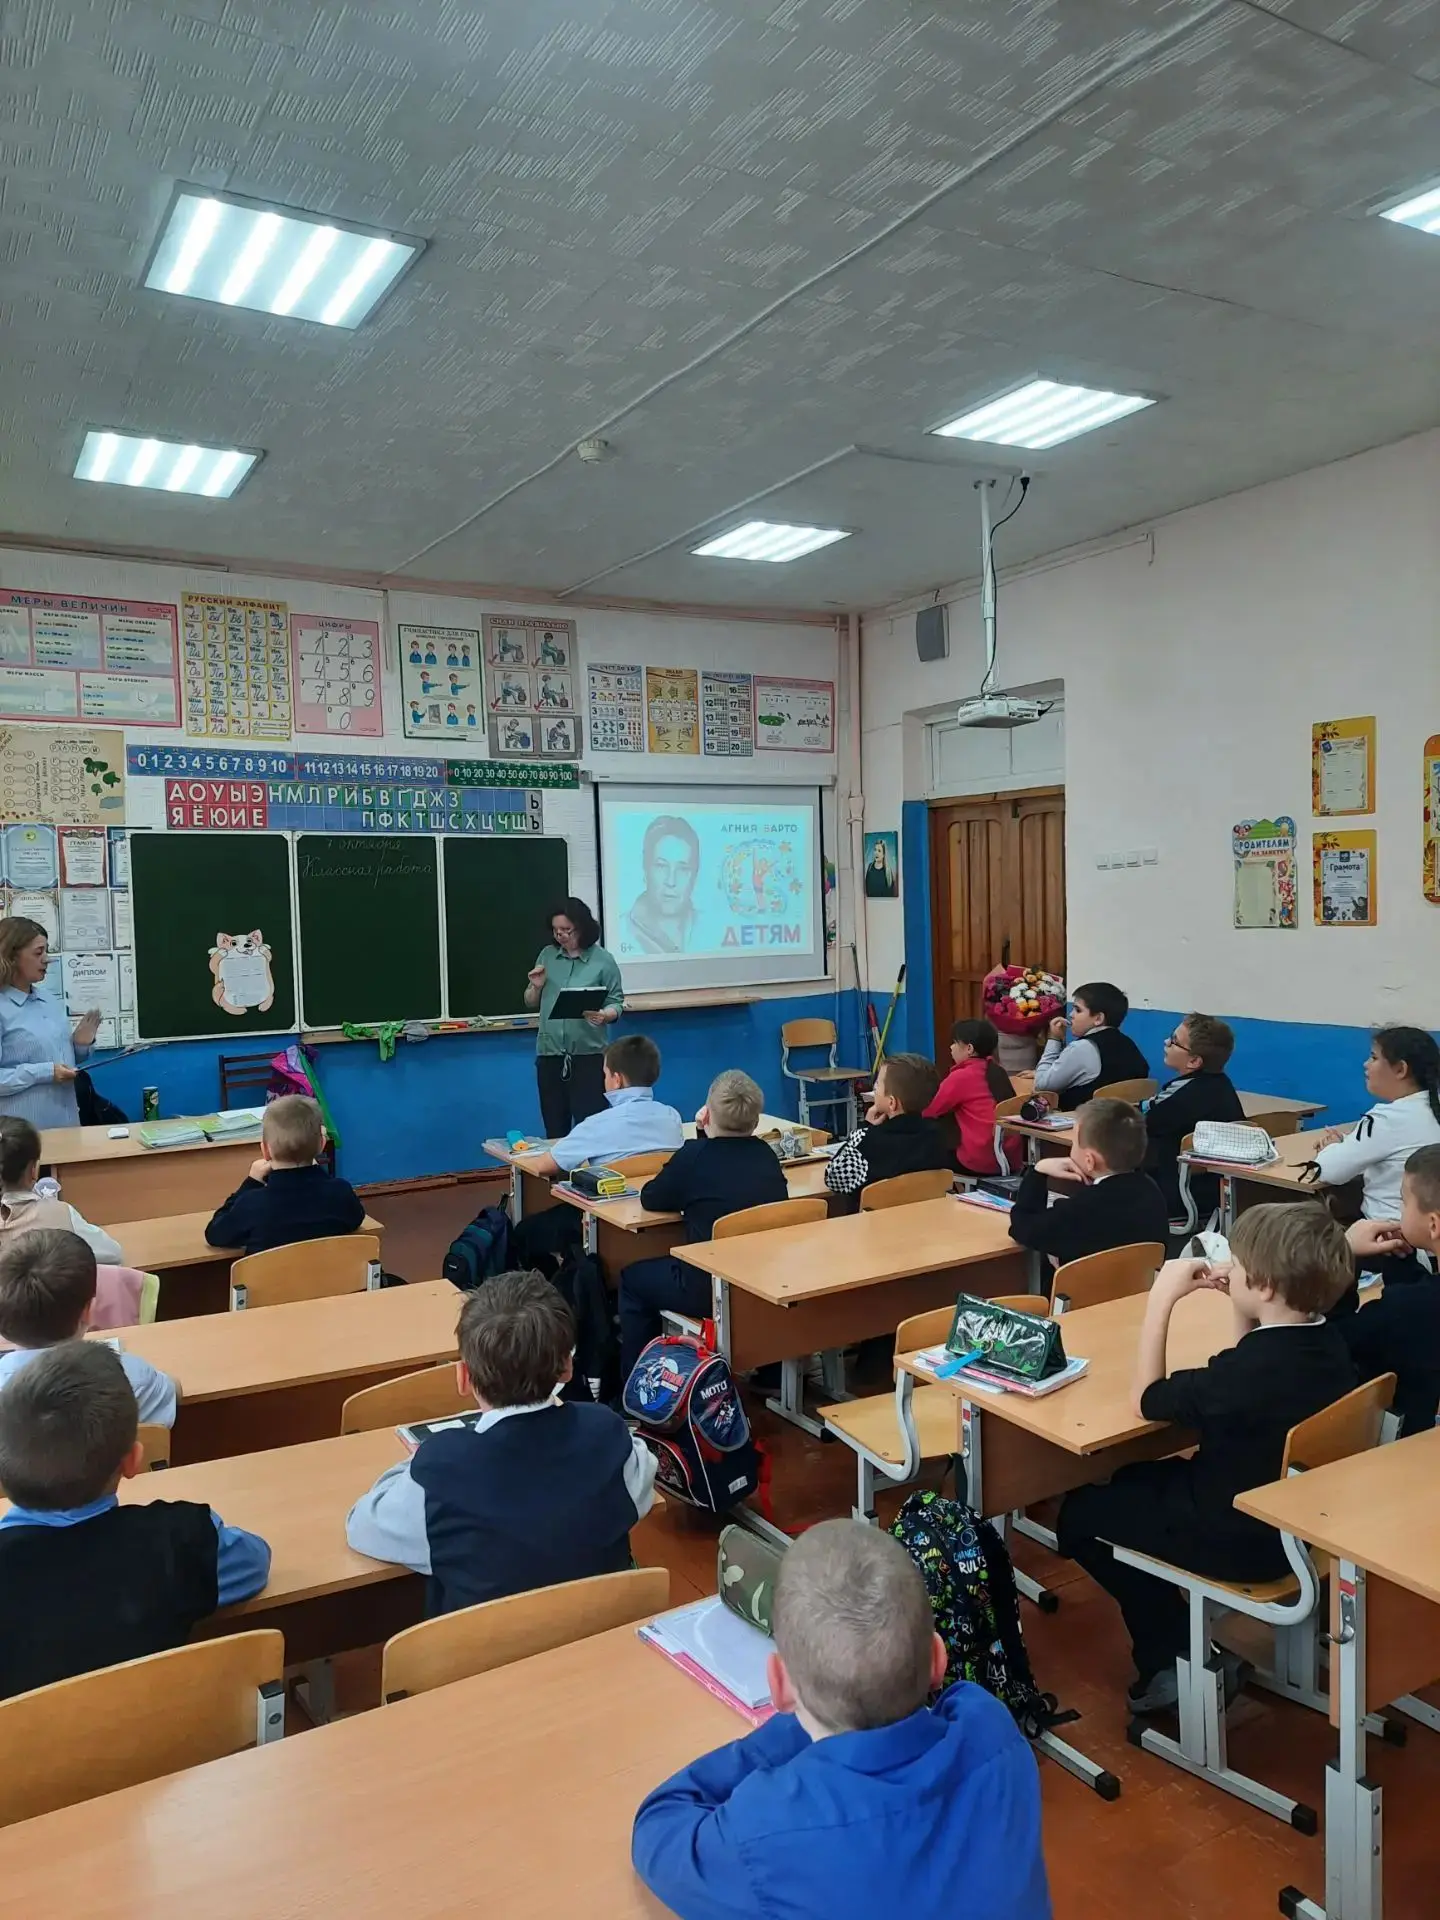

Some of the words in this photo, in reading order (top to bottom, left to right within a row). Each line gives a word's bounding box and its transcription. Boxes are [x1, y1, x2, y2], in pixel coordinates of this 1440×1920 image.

[11, 595, 53, 608] МЕРЫ
[61, 600, 128, 613] ВЕЛИЧИН
[188, 595, 233, 605] РУССКИЙ
[236, 601, 280, 610] АЛФАВИТ
[319, 621, 352, 629] ЦИФРЫ
[315, 636, 323, 654] 1
[338, 638, 349, 656] 2
[362, 640, 372, 658] 3
[315, 661, 324, 679] 4
[339, 663, 350, 680] 5
[363, 664, 373, 682] 6
[591, 676, 596, 684] 1
[617, 677, 622, 686] 6
[704, 684, 712, 692] 11
[315, 685, 324, 703] 7
[339, 688, 350, 705] 8
[364, 689, 375, 707] 9
[591, 692, 597, 700] 2
[618, 693, 623, 701] 7
[705, 700, 713, 708] 12
[729, 701, 738, 709] 17
[592, 707, 597, 715] 3
[618, 708, 624, 716] 8
[340, 712, 351, 730] 0
[705, 714, 714, 722] 13
[592, 722, 599, 730] 4
[619, 722, 624, 731] 9
[705, 728, 714, 736] 14
[593, 737, 599, 745] 5
[619, 737, 629, 746] 10
[706, 742, 715, 750] 15
[730, 743, 739, 751] 20
[138, 753, 146, 767] 0
[151, 754, 158, 767] 1
[164, 755, 173, 768] 2
[178, 755, 187, 768] 3
[192, 756, 201, 769] 4
[206, 756, 214, 770] 5
[219, 757, 228, 770] 6
[232, 757, 241, 771] 7
[245, 758, 253, 772] 8
[258, 759, 266, 772] 9
[271, 759, 287, 773] 10
[305, 762, 316, 774] 11
[318, 762, 330, 774] 12
[332, 763, 344, 775] 13
[347, 763, 358, 774] 14
[360, 764, 371, 775] 15
[373, 764, 384, 775] 16
[387, 764, 398, 776] 17
[400, 765, 411, 777] 18
[413, 766, 424, 777] 19
[426, 766, 438, 777] 20
[454, 766, 460, 776] 0
[463, 767, 472, 777] 10
[474, 767, 483, 777] 20
[486, 767, 494, 778] 30
[497, 768, 506, 778] 40
[508, 768, 518, 779] 50
[519, 769, 528, 779] 60
[529, 769, 538, 779] 70
[539, 769, 548, 780] 80
[549, 770, 558, 780] 90
[560, 770, 572, 781] 100
[721, 824, 758, 833] АГНИЯ
[764, 824, 798, 833] БАРТО
[1239, 839, 1289, 849] РОДИТЕЛЯМ
[299, 853, 371, 877] Классная
[374, 855, 432, 889] работа
[1330, 863, 1360, 872] Грамота
[721, 924, 801, 947] ДЕТЯМ
[620, 942, 634, 952] 6+
[72, 969, 107, 978] ДИПЛОМ
